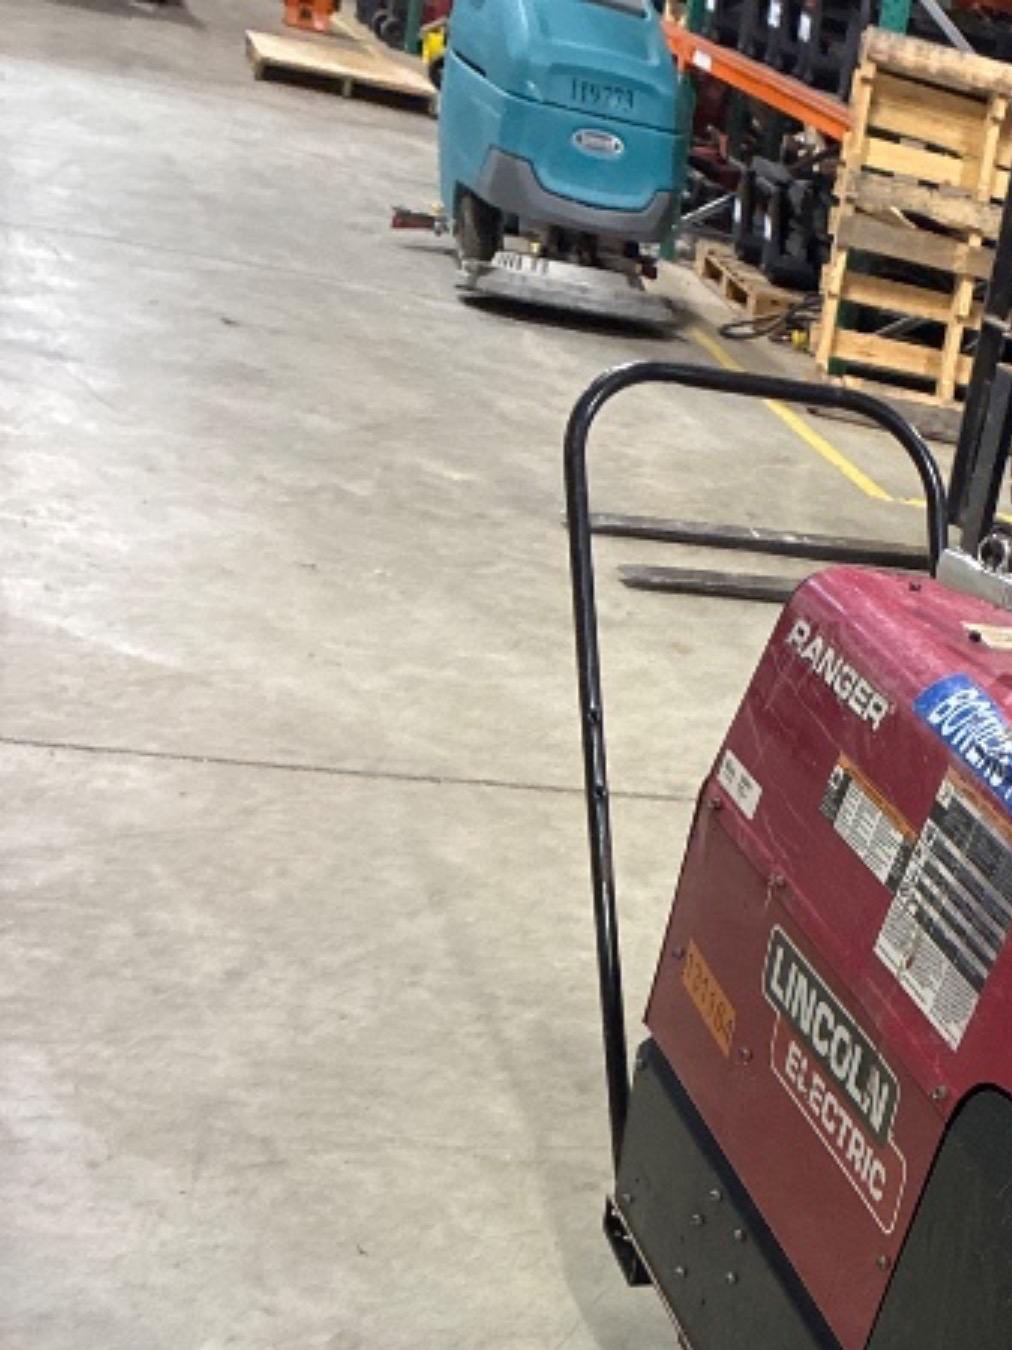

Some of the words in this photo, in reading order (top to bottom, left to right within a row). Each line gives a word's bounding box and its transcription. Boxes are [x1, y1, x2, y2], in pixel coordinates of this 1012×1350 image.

[785, 618, 889, 731] RANGER
[770, 947, 889, 1133] LINCOLN
[784, 1039, 886, 1202] ELECTRIC
